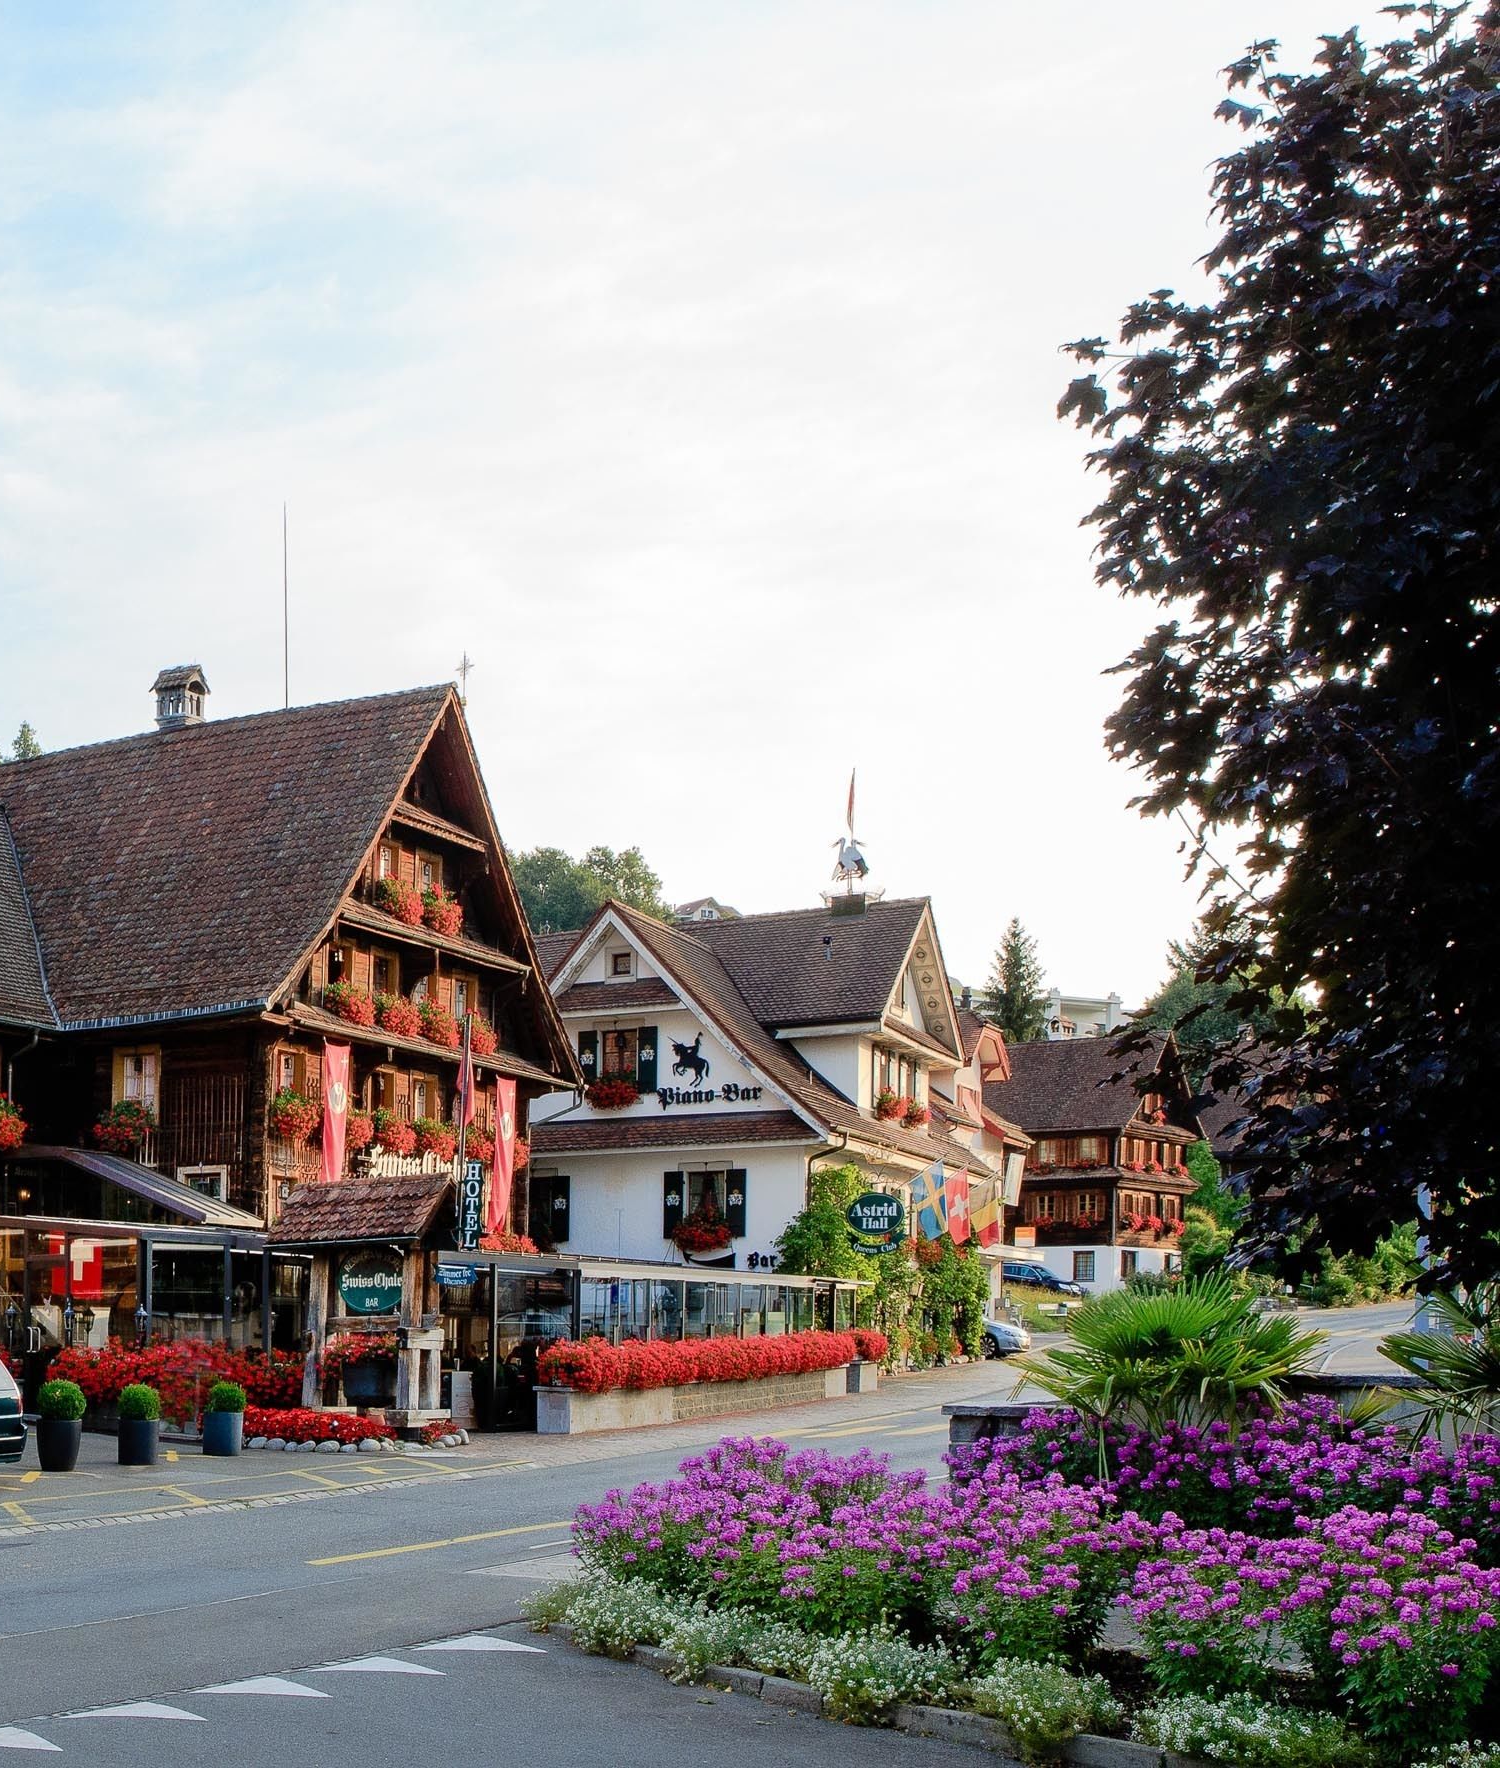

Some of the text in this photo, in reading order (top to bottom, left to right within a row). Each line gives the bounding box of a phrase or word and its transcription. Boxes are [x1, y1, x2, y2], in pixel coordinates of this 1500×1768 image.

[657, 1083, 763, 1111] Piano-Bar
[463, 1163, 482, 1248] HOTEL
[850, 1202, 898, 1217] Astrid
[861, 1217, 889, 1229] Hall
[853, 1242, 897, 1254] Queens Club
[747, 1251, 778, 1269] Bar
[342, 1272, 403, 1291] Swiss Chale
[365, 1298, 379, 1307] BAR
